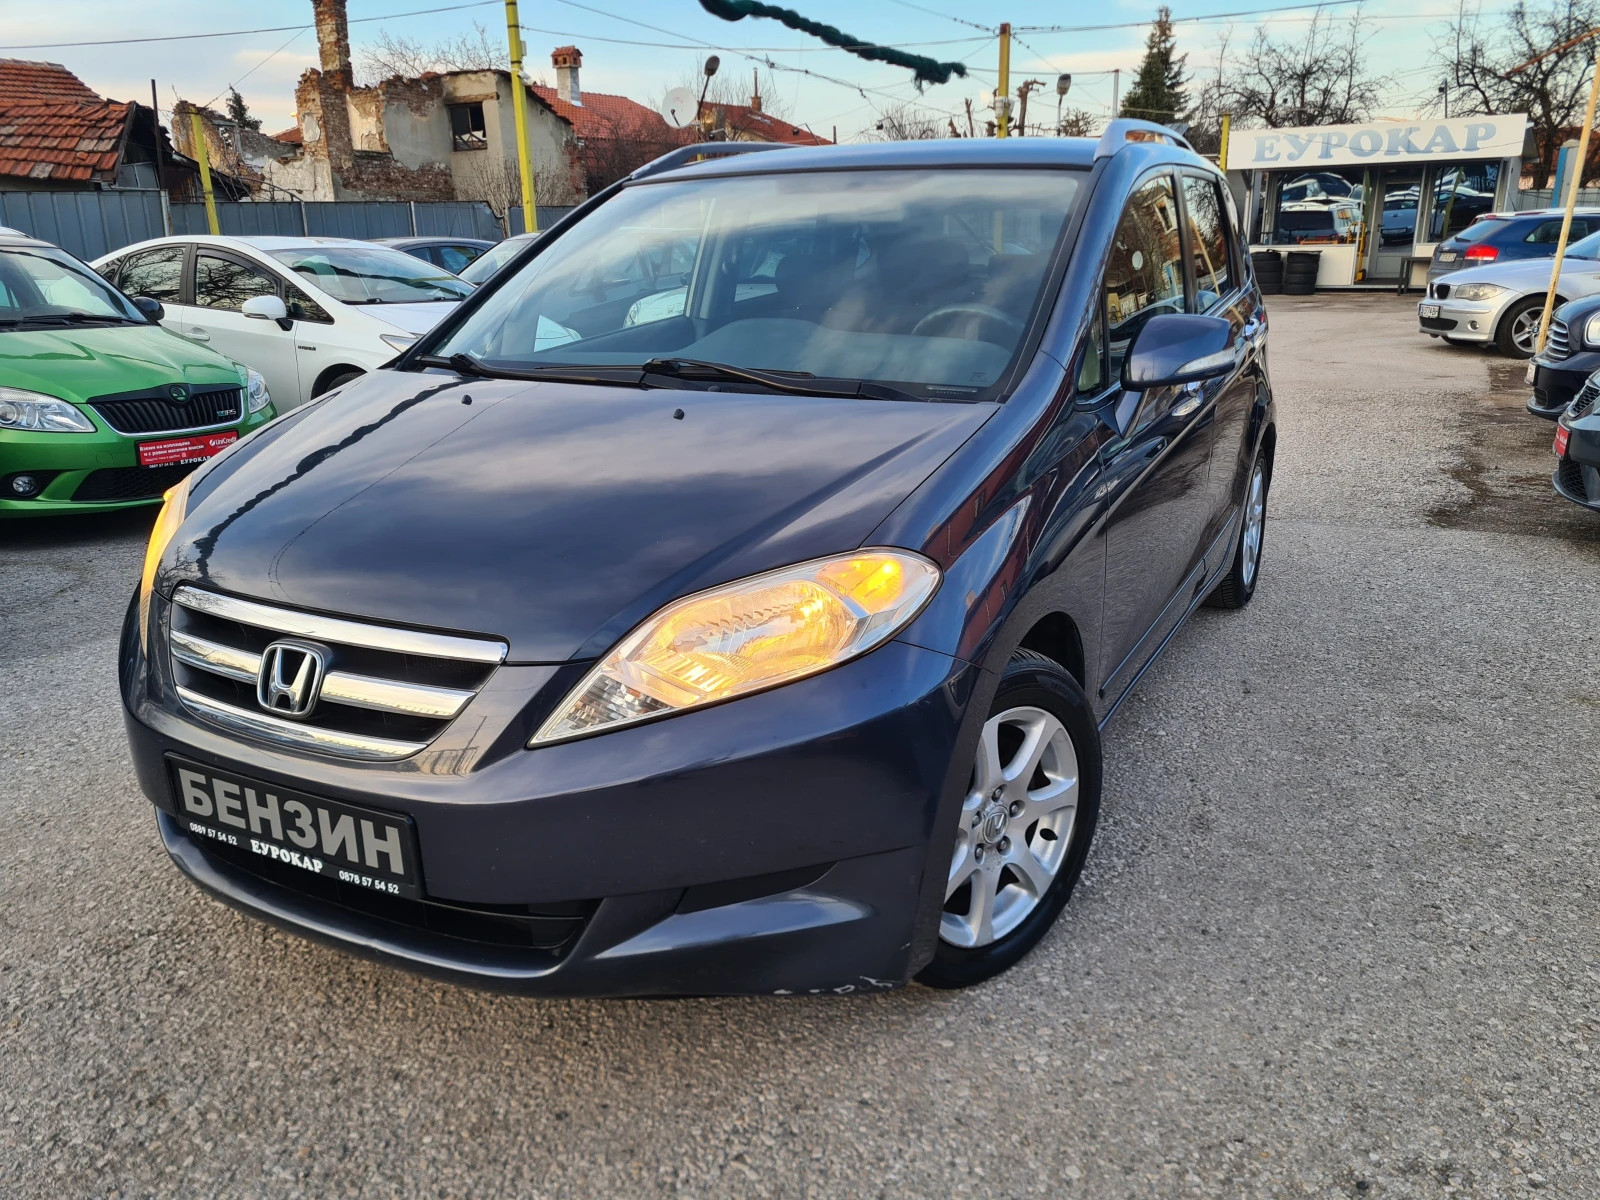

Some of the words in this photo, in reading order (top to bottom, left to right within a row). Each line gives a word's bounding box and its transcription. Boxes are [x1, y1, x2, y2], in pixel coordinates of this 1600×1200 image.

[1252, 122, 1497, 163] ЕУРОКАР
[215, 436, 237, 446] UniCredit
[178, 767, 405, 875] БЕНЗИН
[189, 822, 206, 837] 0889
[207, 828, 216, 839] 57
[217, 830, 227, 842] 54
[227, 833, 238, 846] 52
[250, 839, 323, 873] ЕУРОКАР
[339, 870, 360, 885] 0878
[361, 874, 373, 888] 57
[374, 879, 386, 891] 54
[387, 883, 400, 895] 52
